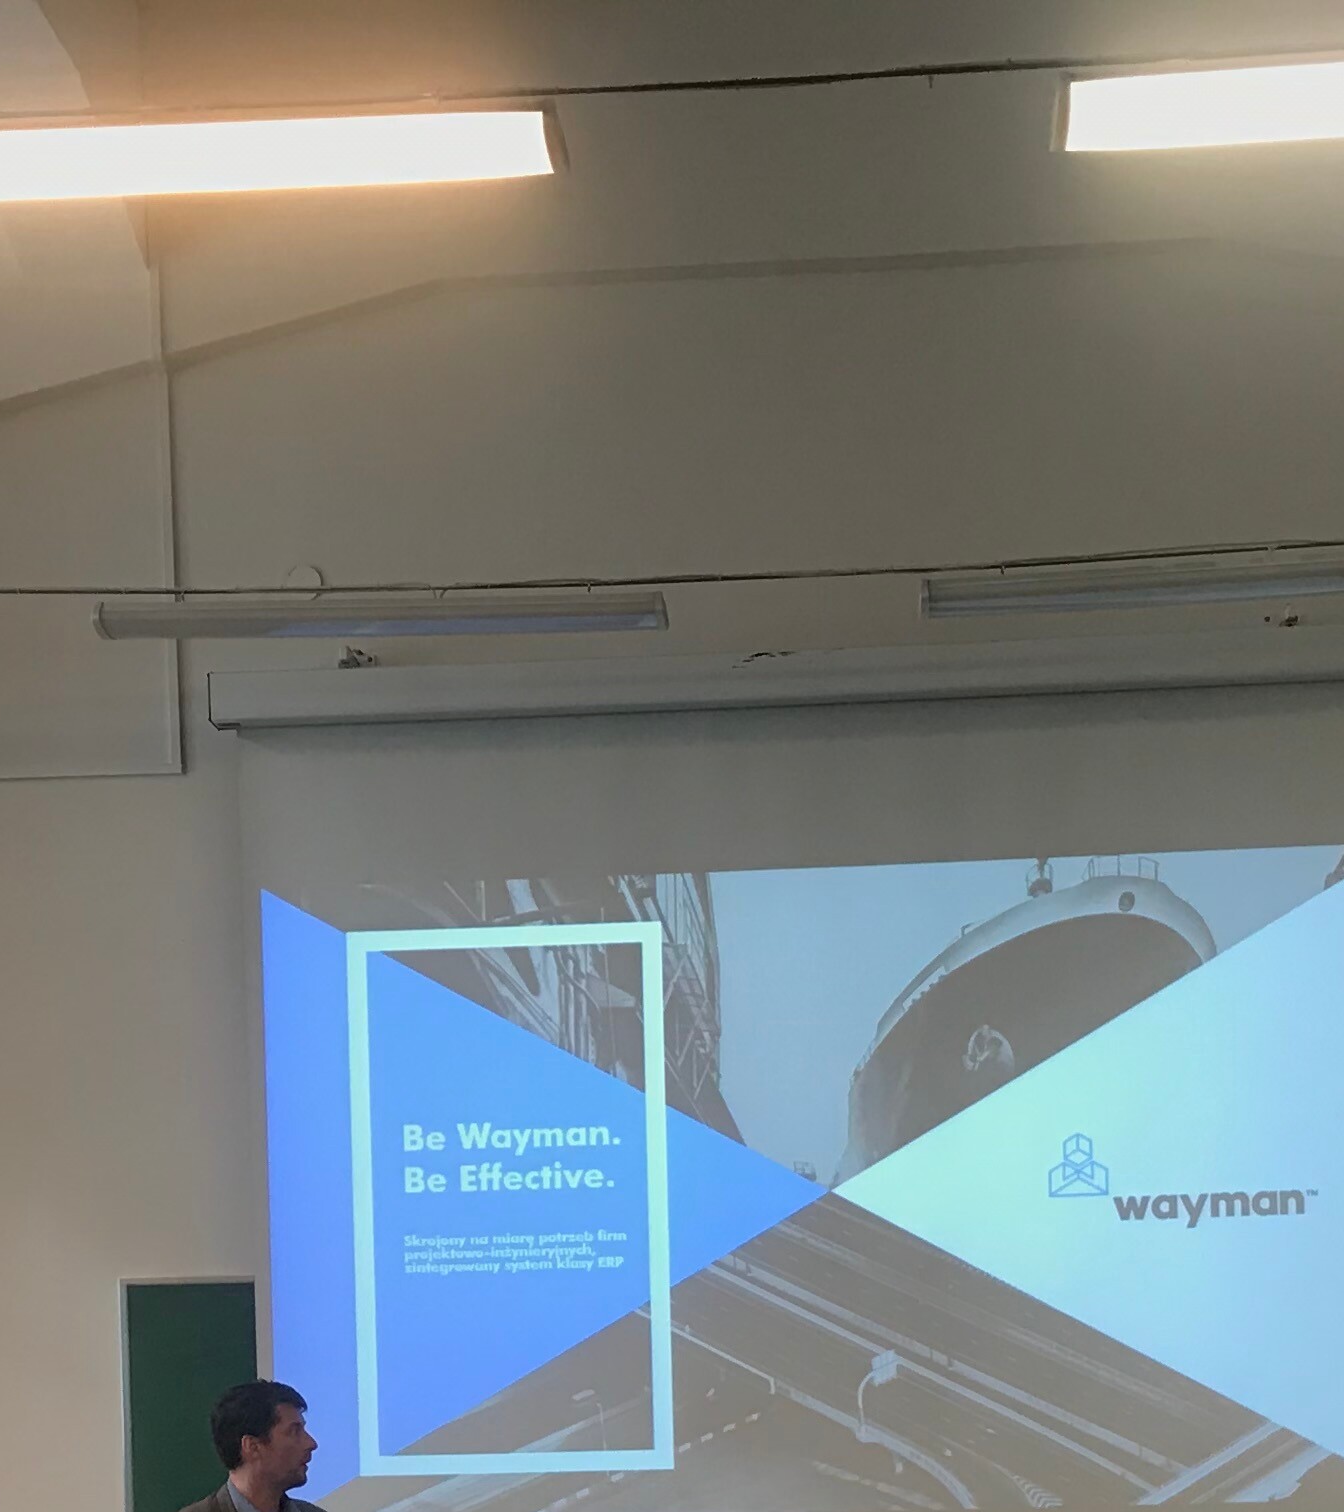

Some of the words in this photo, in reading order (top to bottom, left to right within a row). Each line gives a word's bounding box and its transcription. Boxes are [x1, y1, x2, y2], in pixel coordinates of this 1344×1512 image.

[402, 1124, 447, 1152] Be
[456, 1121, 621, 1156] Wayman.
[404, 1166, 447, 1194] Be
[459, 1161, 615, 1192] Effective.
[403, 1234, 466, 1248] Skrojony
[470, 1236, 489, 1246] na
[492, 1234, 534, 1247] miarę
[538, 1231, 594, 1246] potrzeb
[597, 1229, 628, 1242] firm
[404, 1259, 500, 1276] zintegrowany
[504, 1258, 553, 1274] system
[556, 1256, 594, 1272] klasy
[597, 1256, 625, 1269] ERP
